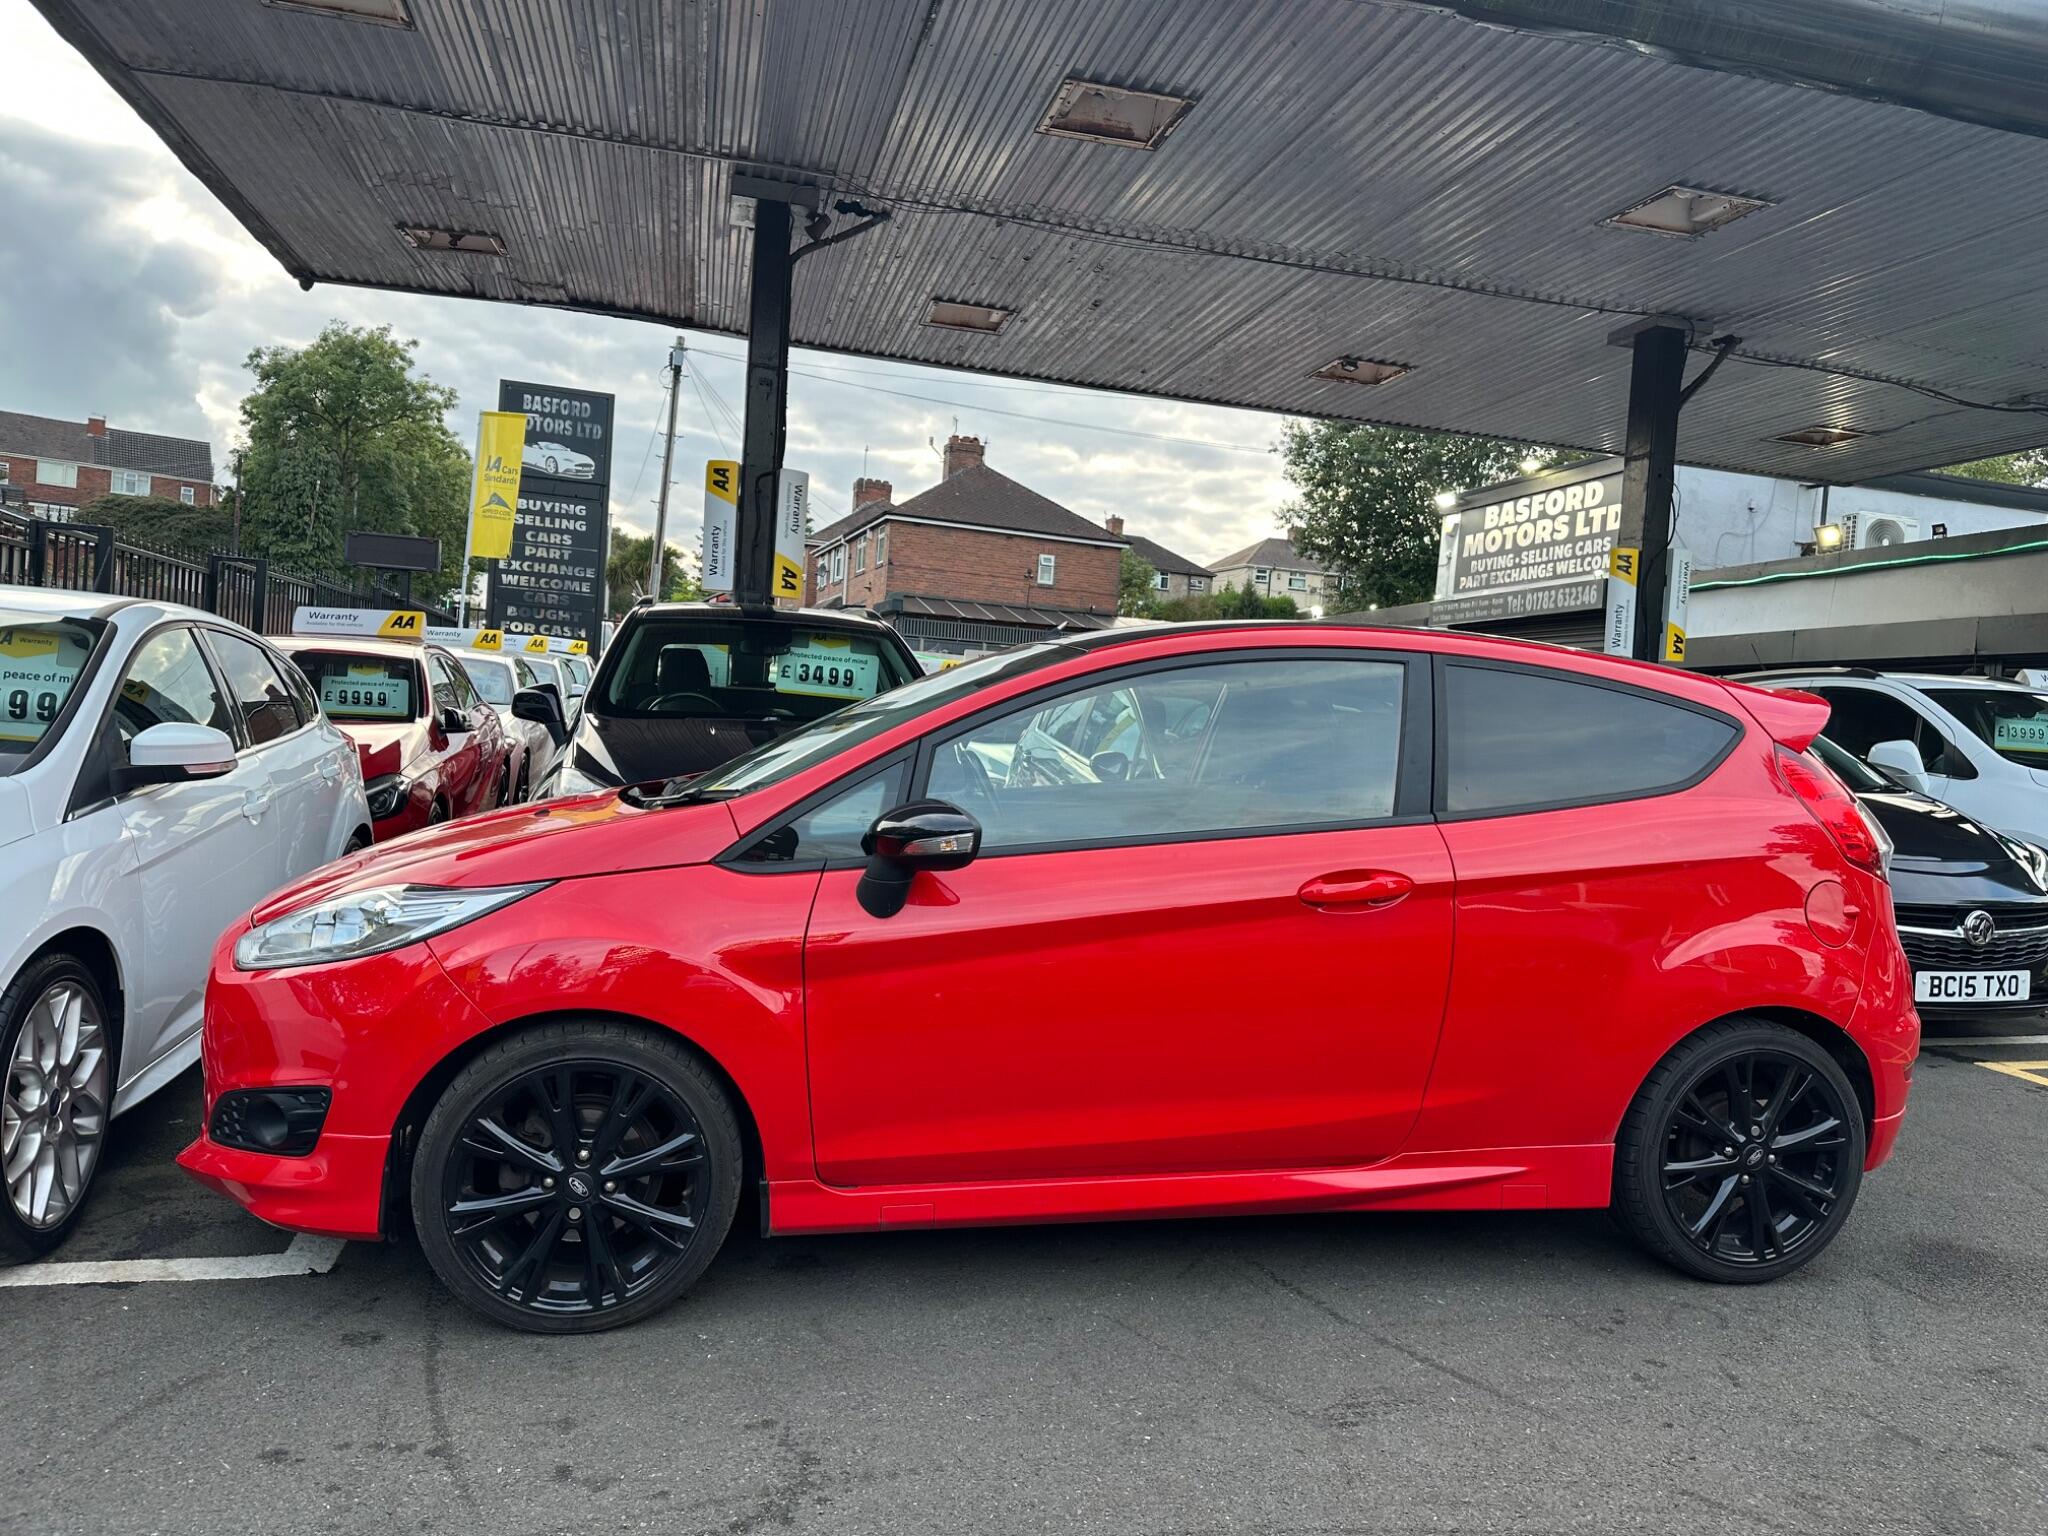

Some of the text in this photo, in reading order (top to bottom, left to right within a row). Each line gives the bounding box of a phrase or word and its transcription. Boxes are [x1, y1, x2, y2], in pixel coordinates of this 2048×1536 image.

[523, 394, 591, 418] BASFORD
[526, 416, 602, 440] OTORS LTD
[517, 498, 587, 516] BUYING
[1484, 480, 1604, 529] BASFORD
[514, 513, 587, 531] SELLING
[709, 467, 730, 576] Warranty AA
[1463, 503, 1622, 558] MOTORS LTD
[525, 530, 573, 545] CARS
[781, 484, 803, 591] Warranty AA
[524, 545, 573, 560] PART
[1470, 536, 1611, 573] BUYING SELLING CARS
[498, 559, 596, 578] EXCHANGE
[1459, 554, 1610, 589] PART EXCHANGE WELCOM
[501, 573, 591, 592] WELCOME
[522, 591, 570, 606] CARS
[1507, 584, 1597, 614] Tel: 01782 632346
[1611, 554, 1633, 648] Warranty AA
[1673, 561, 1690, 655] Warranty AA
[309, 611, 416, 629] Warranty AA
[506, 605, 583, 622] BOUGHT
[0, 630, 53, 646] A Warranty
[426, 630, 497, 644] Warranty AA
[500, 620, 587, 638] FOR CASH
[531, 639, 544, 648] AA
[573, 642, 584, 650] AA
[789, 651, 822, 660] Protected
[3, 670, 74, 683] peace of mi
[0, 689, 58, 721] 99
[1928, 975, 2019, 998] BC15 TXO
